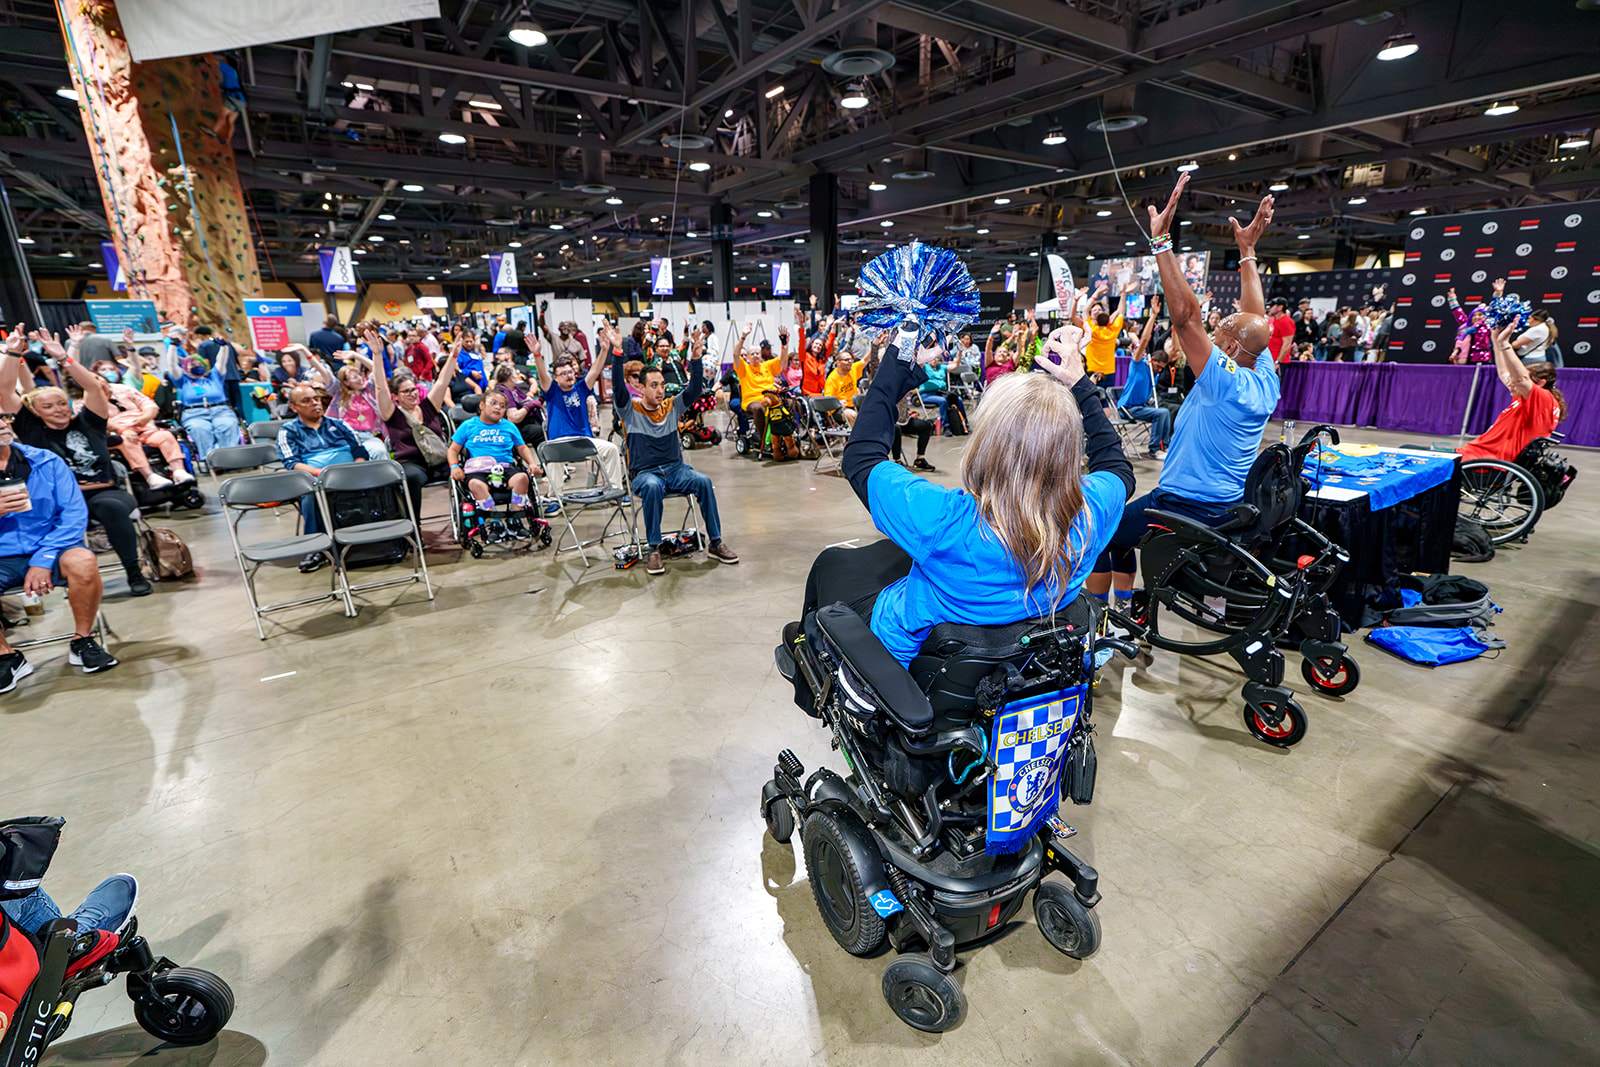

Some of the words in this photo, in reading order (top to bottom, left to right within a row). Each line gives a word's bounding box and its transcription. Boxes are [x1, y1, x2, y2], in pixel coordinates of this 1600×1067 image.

[1060, 267, 1072, 287] ATC
[1003, 718, 1071, 747] CHELSEA
[1019, 759, 1052, 777] CHELSEA
